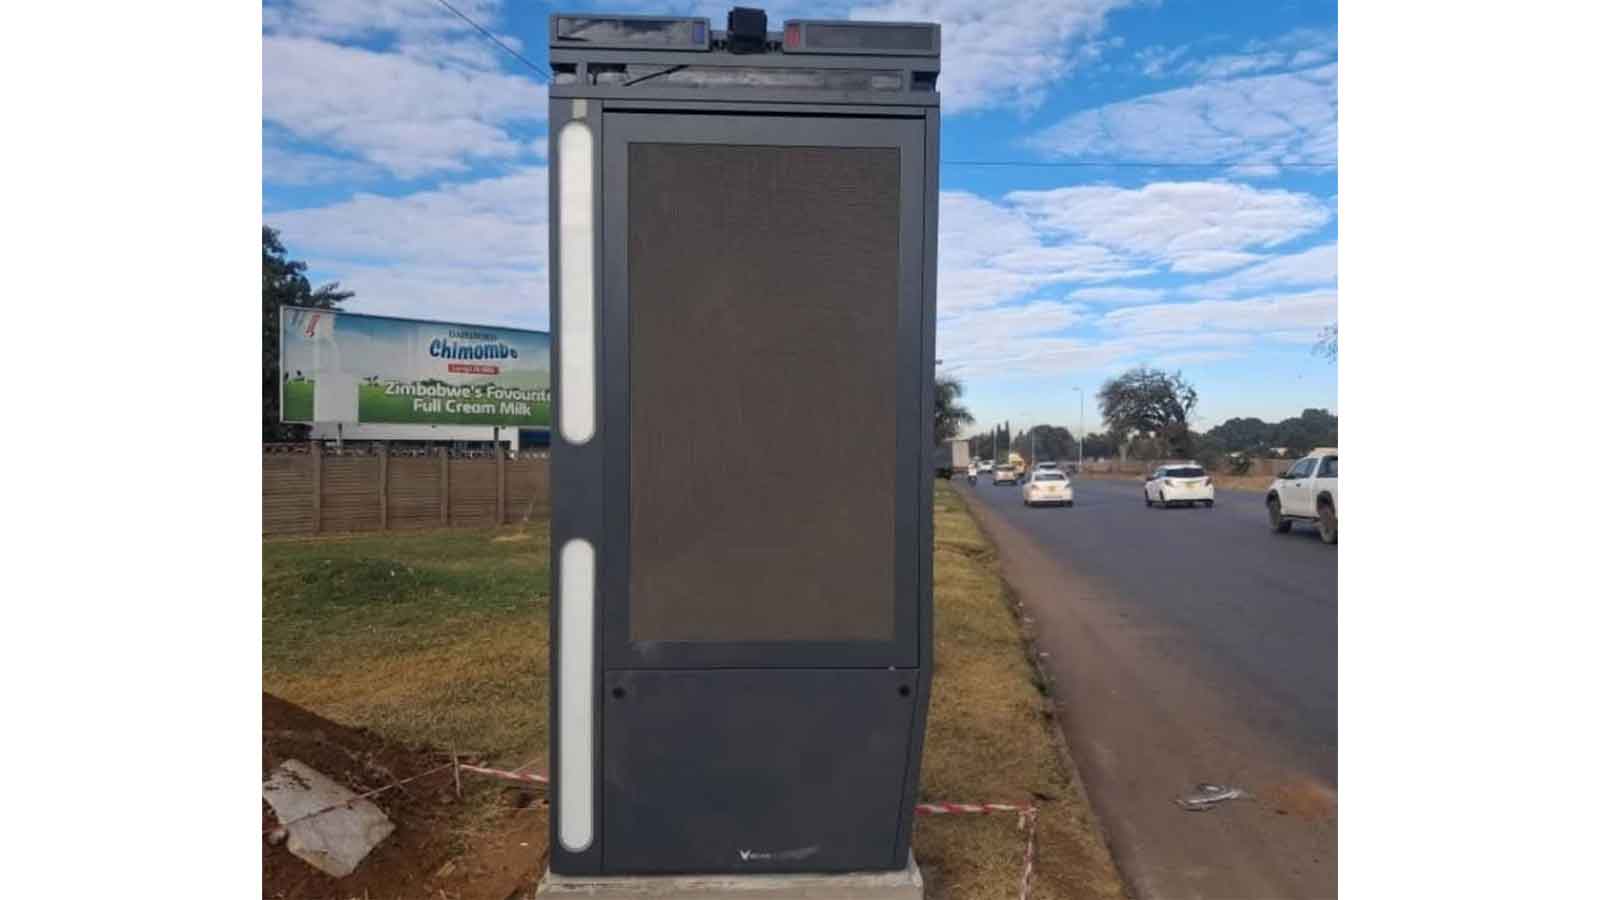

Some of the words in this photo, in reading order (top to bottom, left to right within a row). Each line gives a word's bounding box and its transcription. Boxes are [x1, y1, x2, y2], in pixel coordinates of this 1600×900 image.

[384, 381, 482, 398] Zimbabwe's
[413, 398, 441, 413] Full
[446, 399, 496, 414] Cream
[500, 401, 531, 416] Milk
